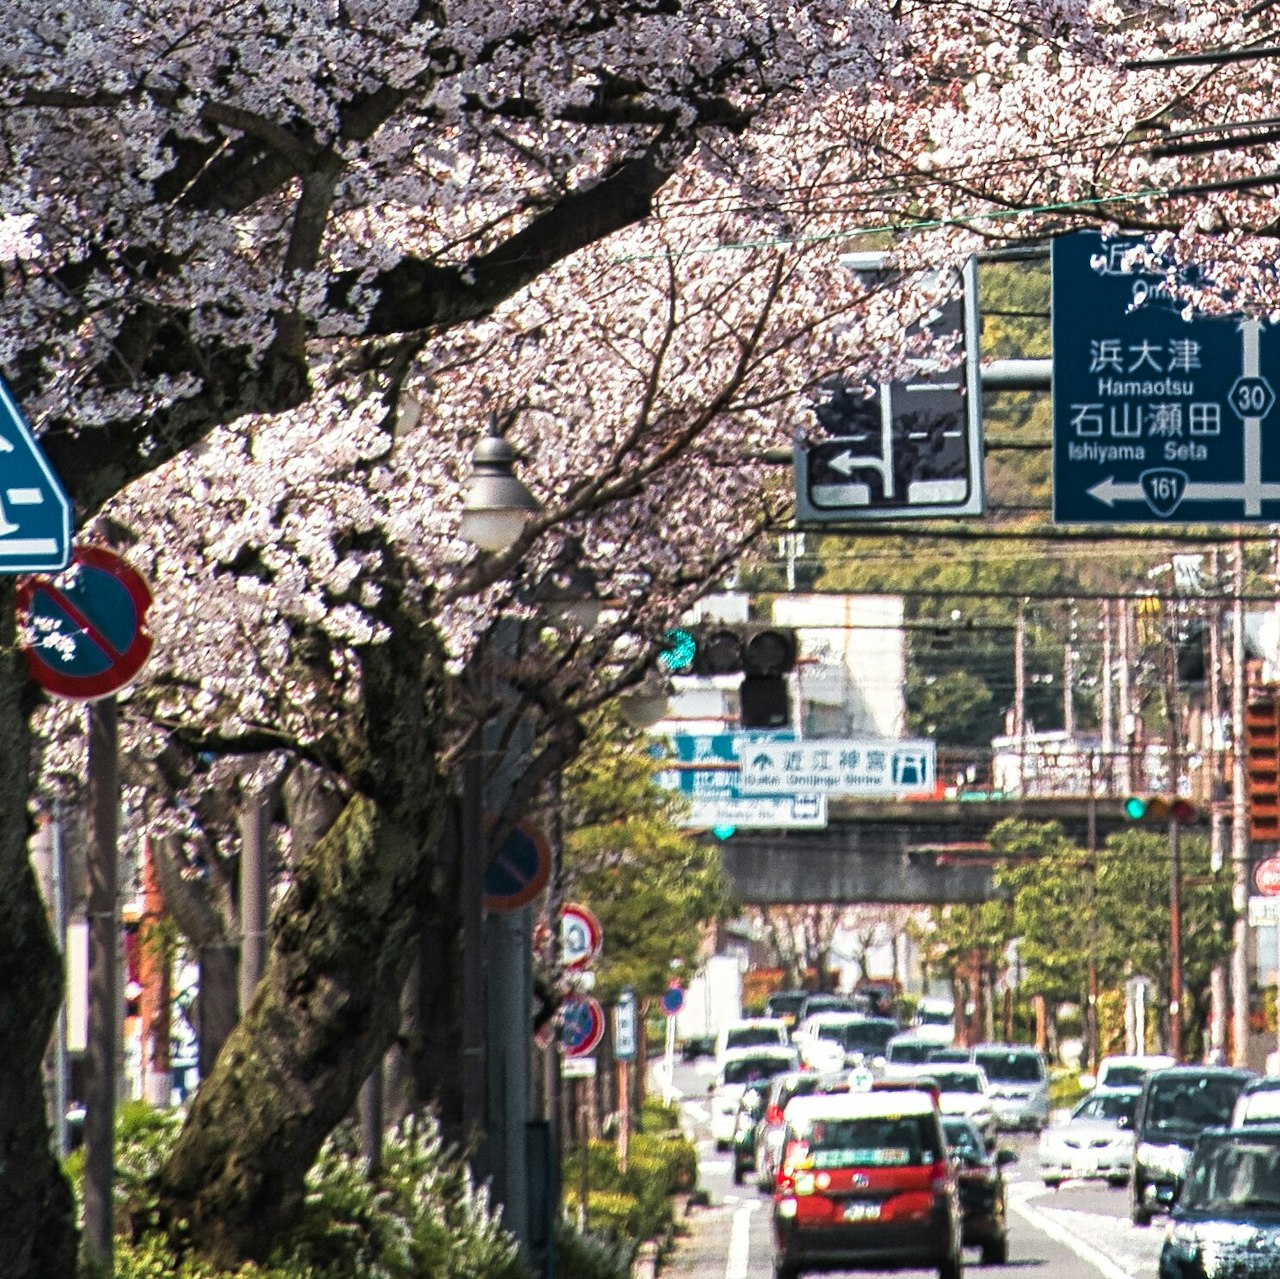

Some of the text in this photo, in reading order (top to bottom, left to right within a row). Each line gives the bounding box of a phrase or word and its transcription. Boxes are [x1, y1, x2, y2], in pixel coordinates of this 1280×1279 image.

[1090, 338, 1202, 373] 浜大津
[1098, 377, 1194, 396] Hamaotsu
[1238, 385, 1265, 410] 30
[1069, 441, 1207, 465] Ishiyama Seta
[1150, 477, 1178, 499] 161
